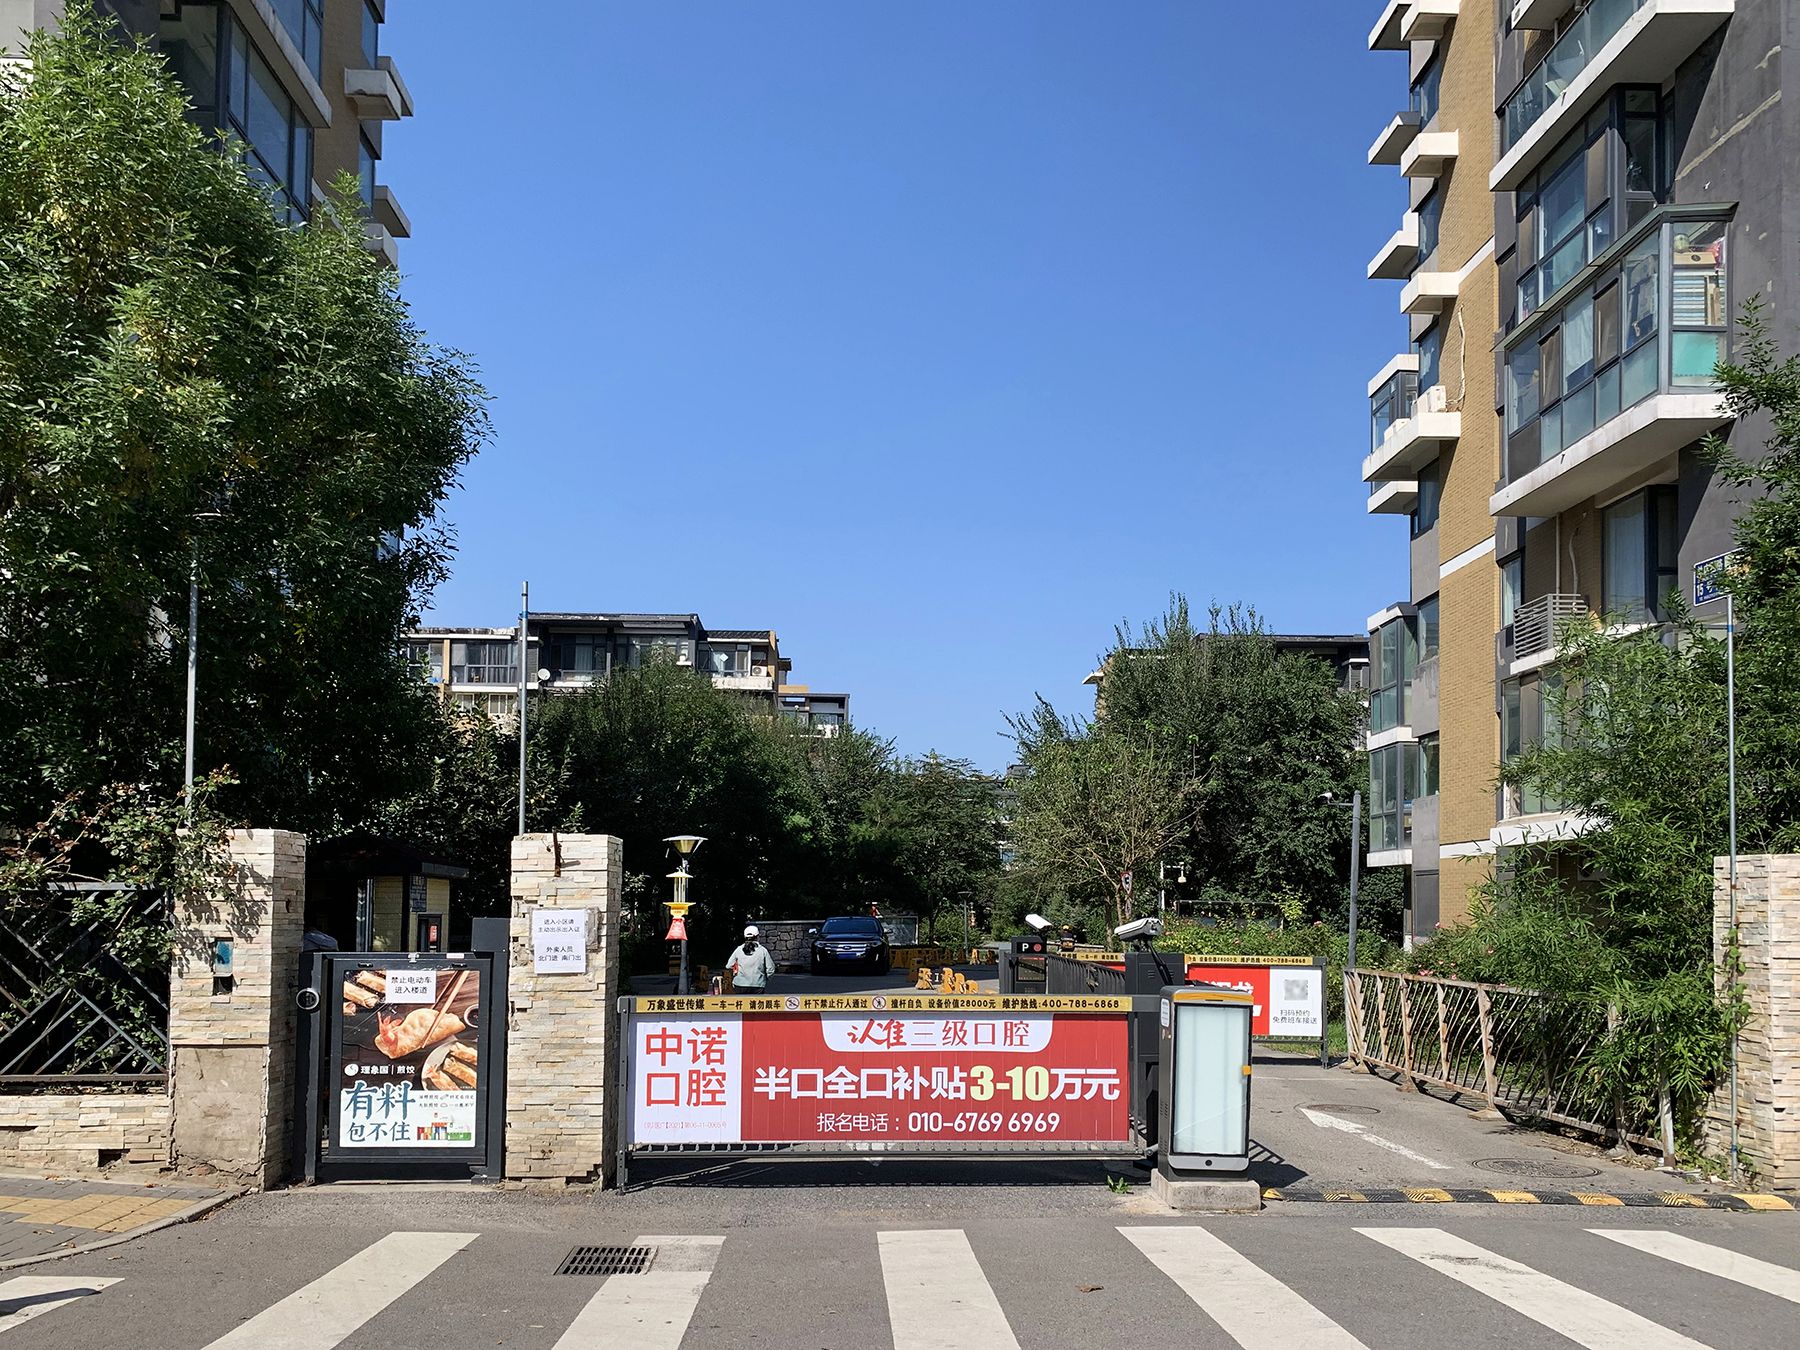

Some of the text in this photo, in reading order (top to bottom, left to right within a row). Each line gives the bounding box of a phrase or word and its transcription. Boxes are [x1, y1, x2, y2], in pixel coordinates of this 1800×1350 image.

[1022, 943, 1029, 952] P
[391, 976, 432, 984] 禁止电动车
[395, 987, 428, 995] 进入楼道
[647, 999, 705, 1011] 万象盛世传媒
[711, 1000, 743, 1010] 一车一杆
[749, 1000, 781, 1010] 请勿跟车
[804, 999, 868, 1009] 杆下禁止行人通过
[891, 999, 923, 1009] 撞杆自负
[928, 999, 996, 1009] 设备价值28000元
[1272, 1017, 1318, 1025] 免费班车接送
[645, 1027, 728, 1067] 中诺
[397, 1065, 416, 1074] 煎饺
[645, 1068, 728, 1107] 口腔
[754, 1065, 1120, 1101] 半口全口补贴3-10万元
[344, 1082, 416, 1121] 有料
[346, 1121, 411, 1142] 包不住
